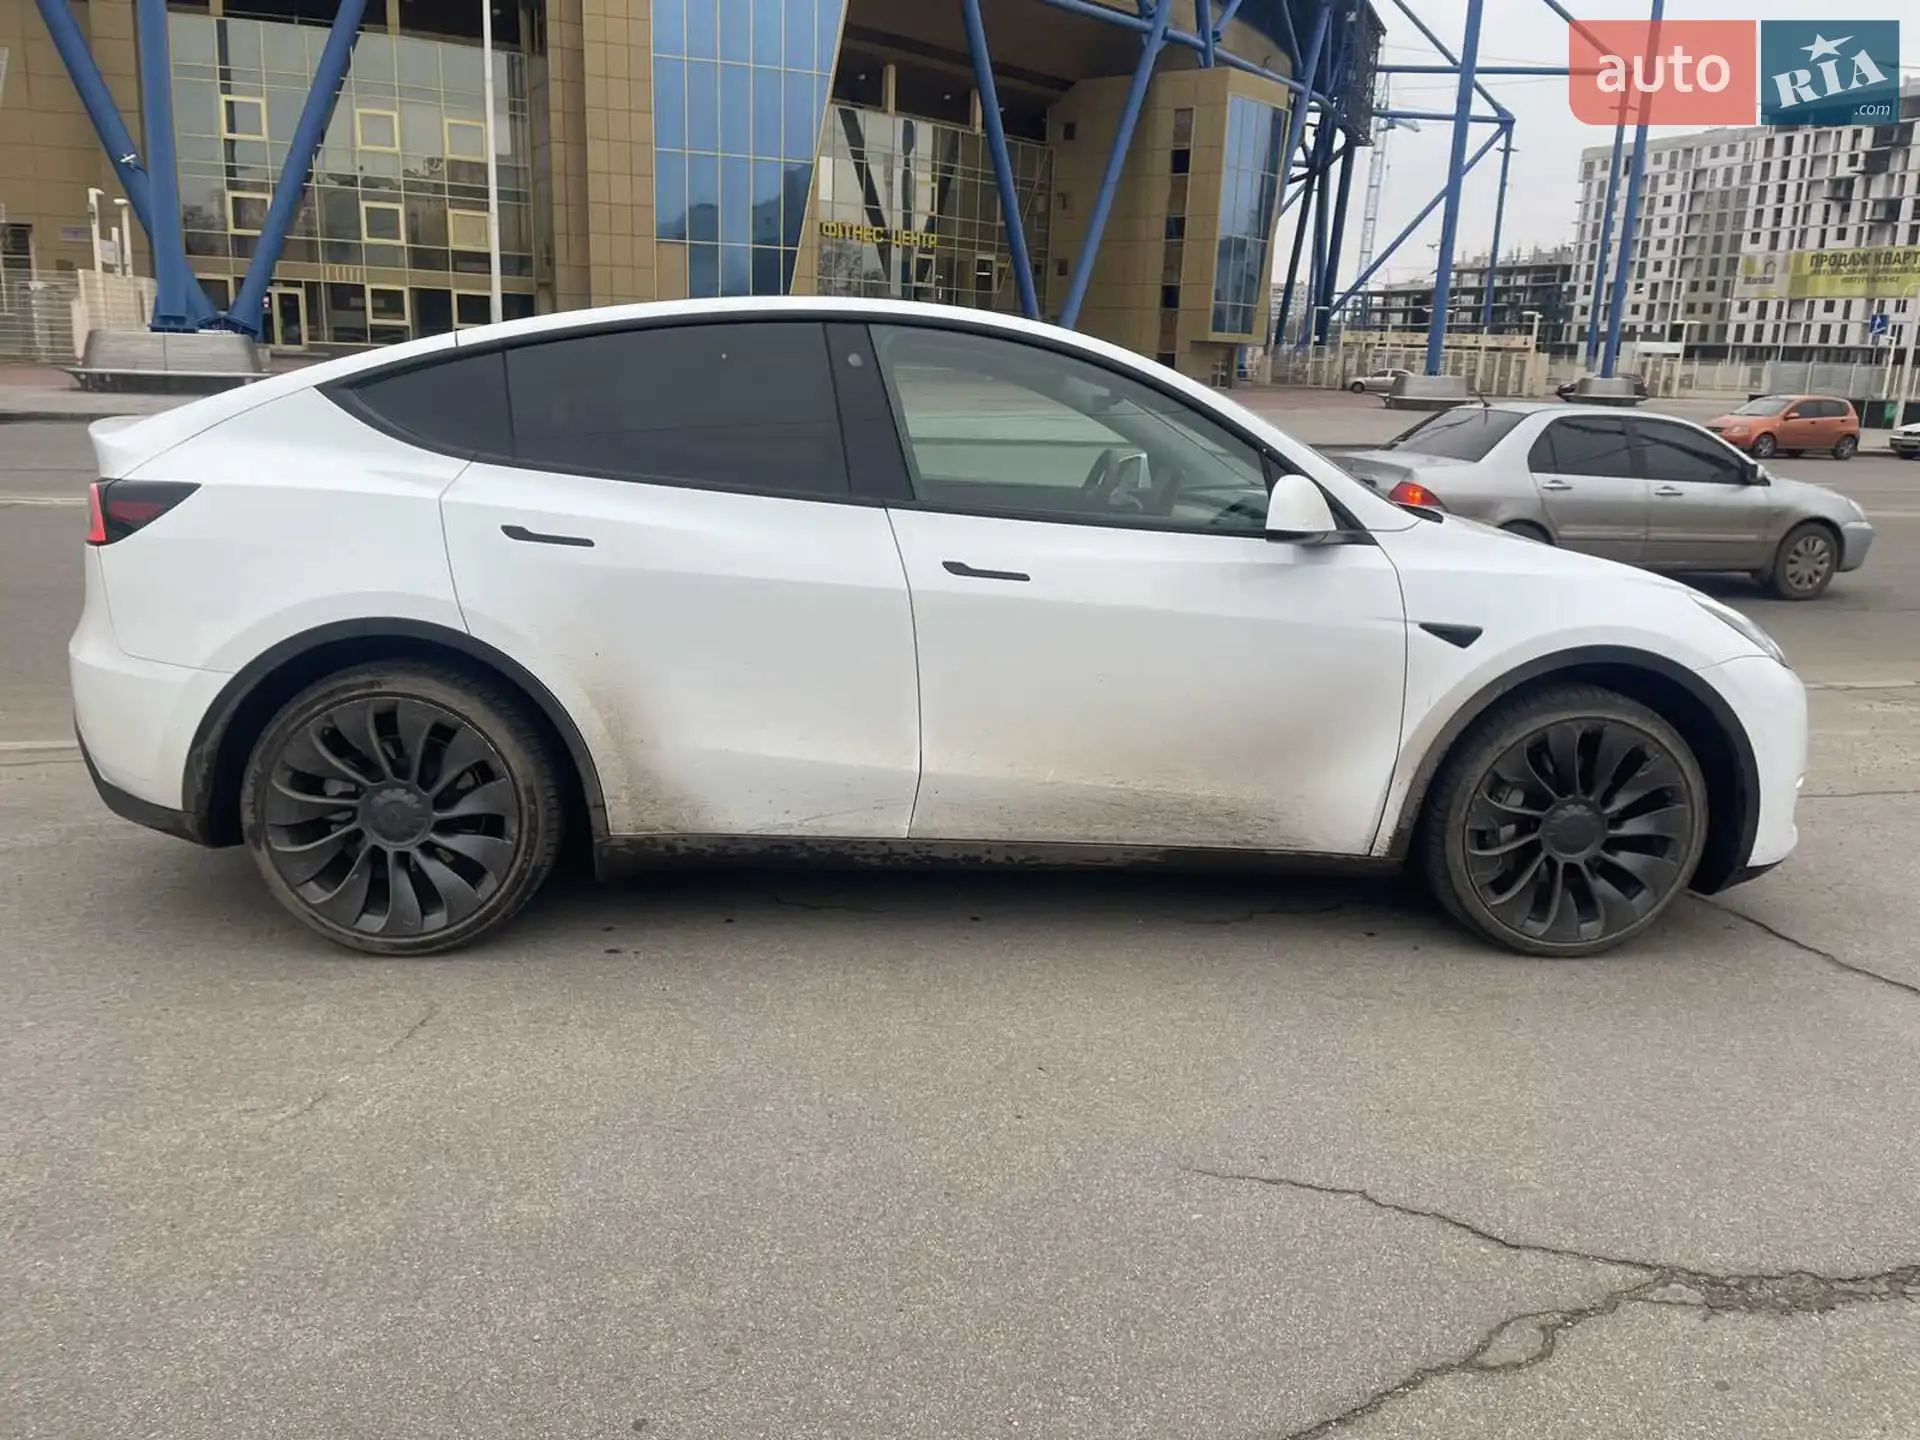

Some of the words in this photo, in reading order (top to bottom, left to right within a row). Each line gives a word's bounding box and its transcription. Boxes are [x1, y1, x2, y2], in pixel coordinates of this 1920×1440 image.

[821, 221, 885, 243] ФІТНЕС
[892, 230, 939, 248] ЦЕНТР
[1810, 252, 1869, 267] ПРОДАЖ
